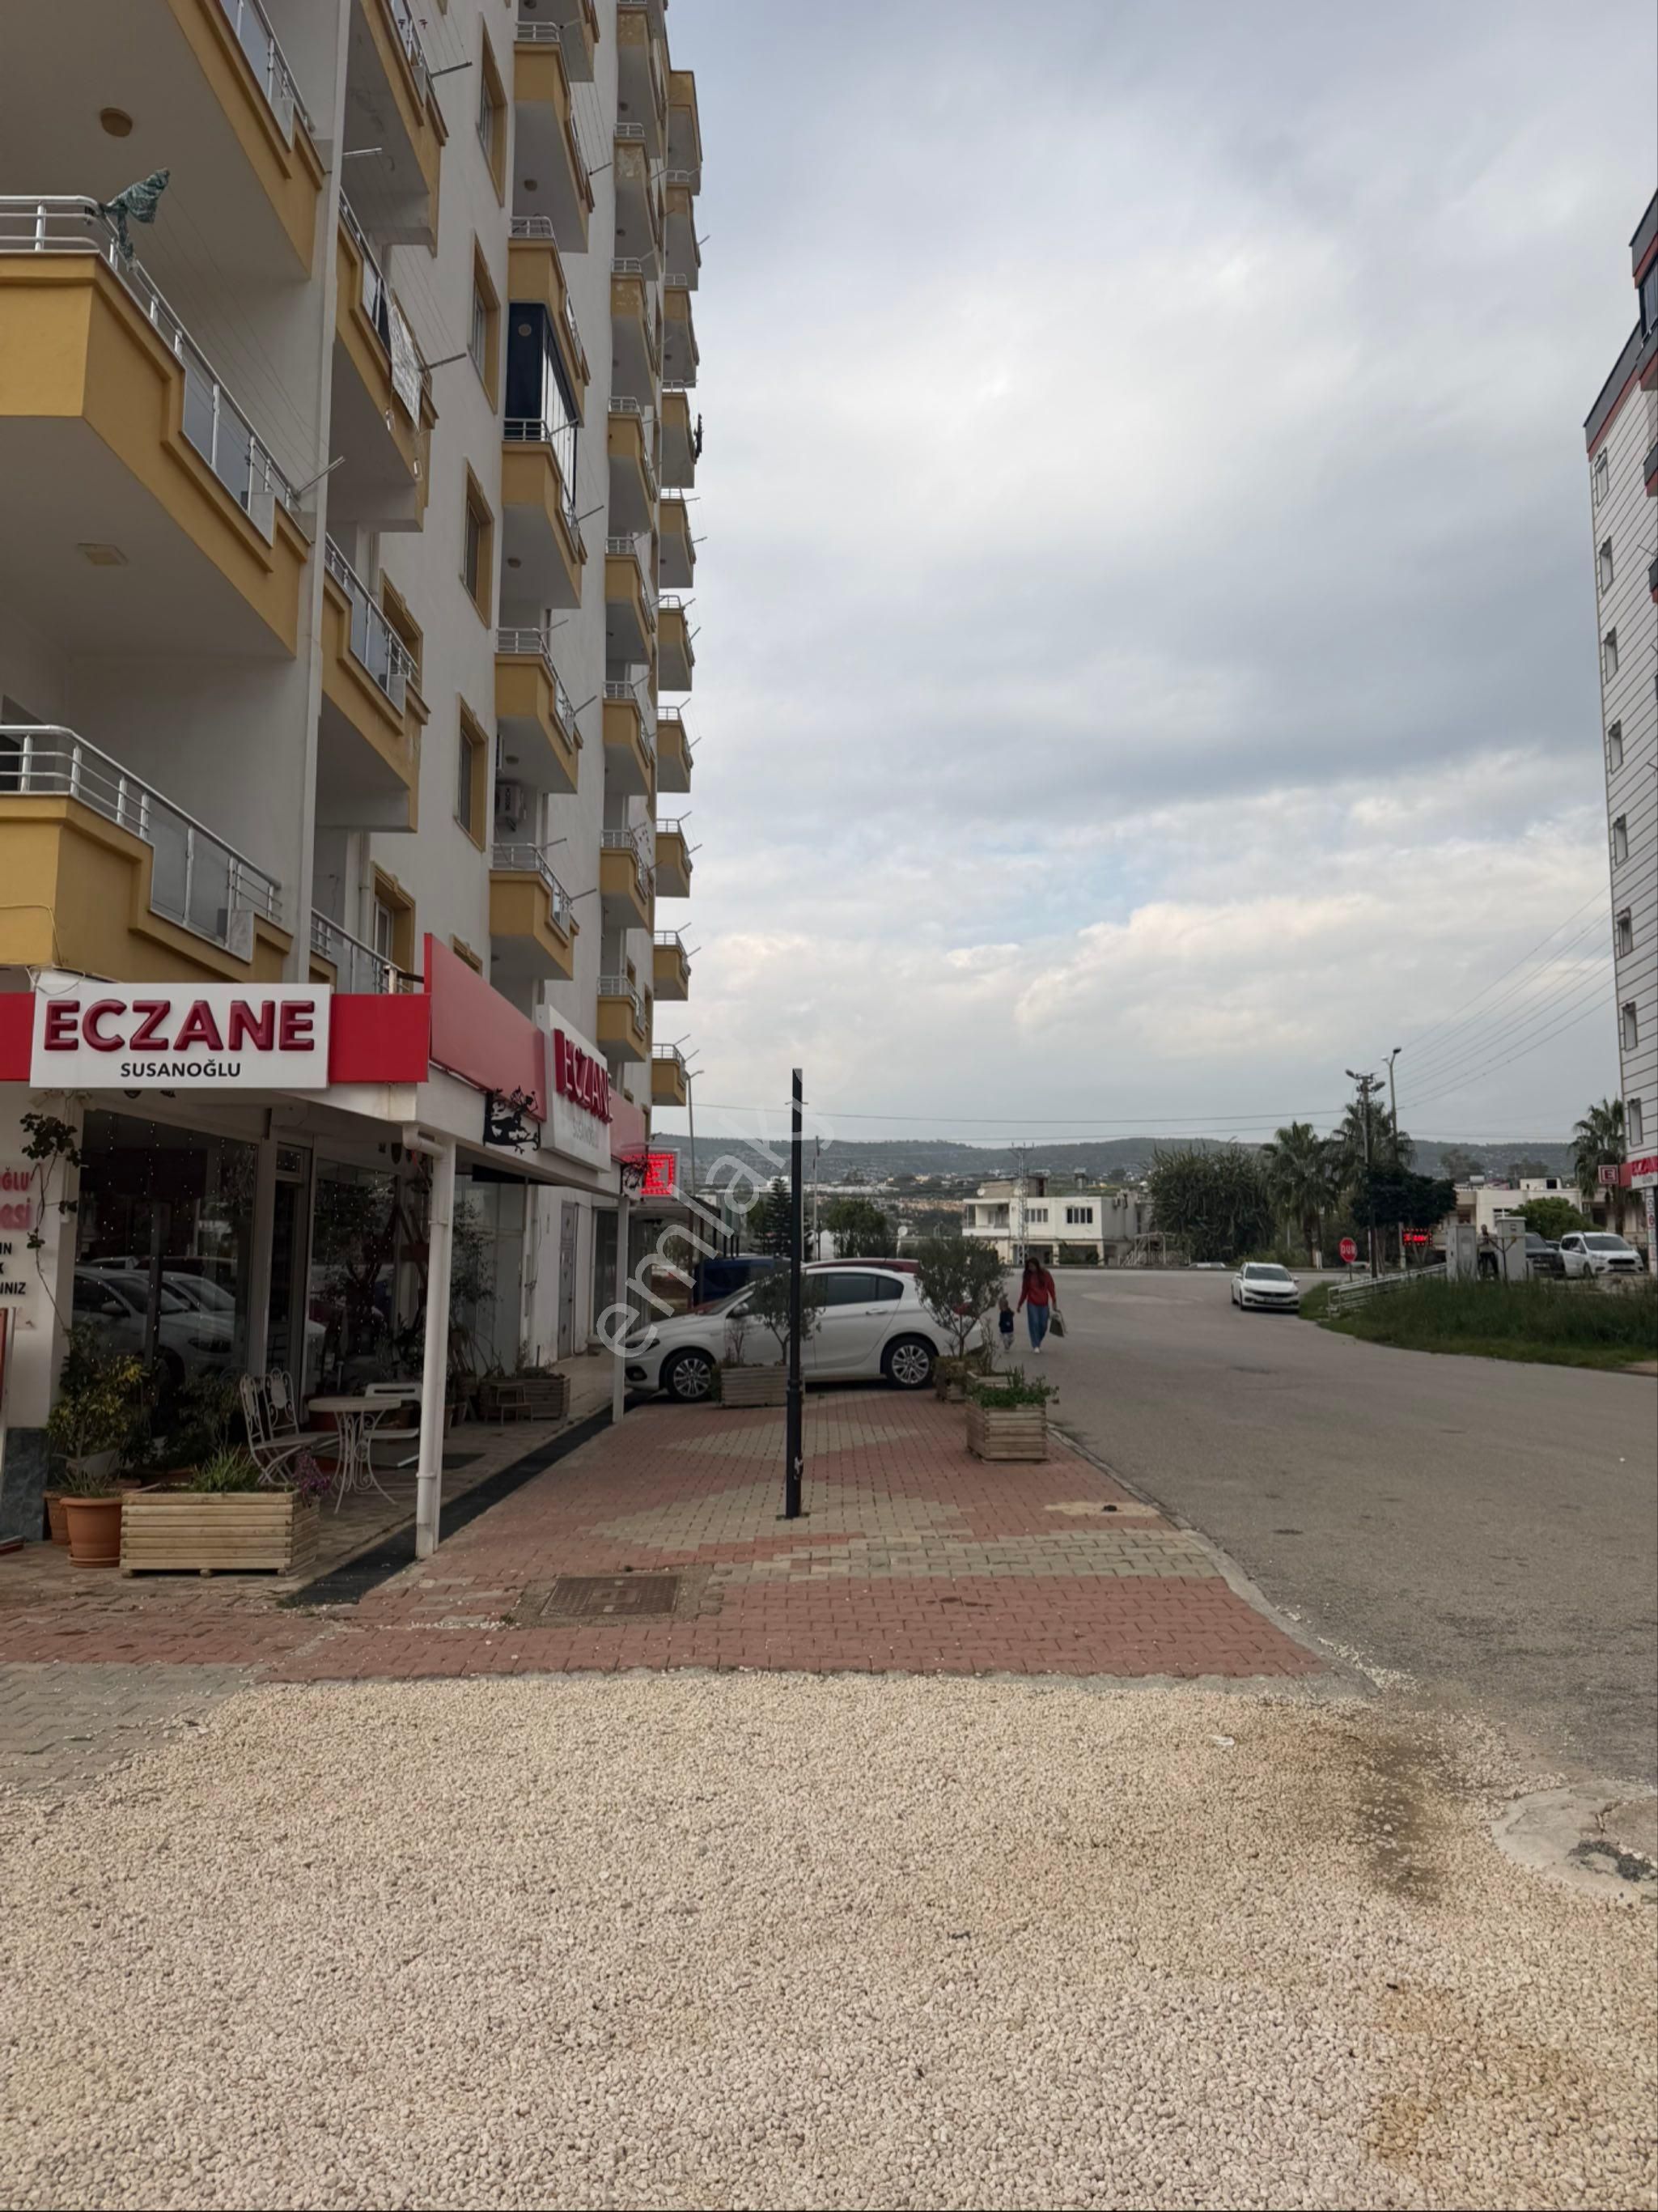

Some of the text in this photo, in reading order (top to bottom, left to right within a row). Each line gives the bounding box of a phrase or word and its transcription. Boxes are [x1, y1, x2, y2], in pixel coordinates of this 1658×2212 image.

[44, 999, 316, 1052] ECZANE
[121, 1059, 241, 1077] SUSANOĞLU
[0, 1165, 30, 1192] ĞLU
